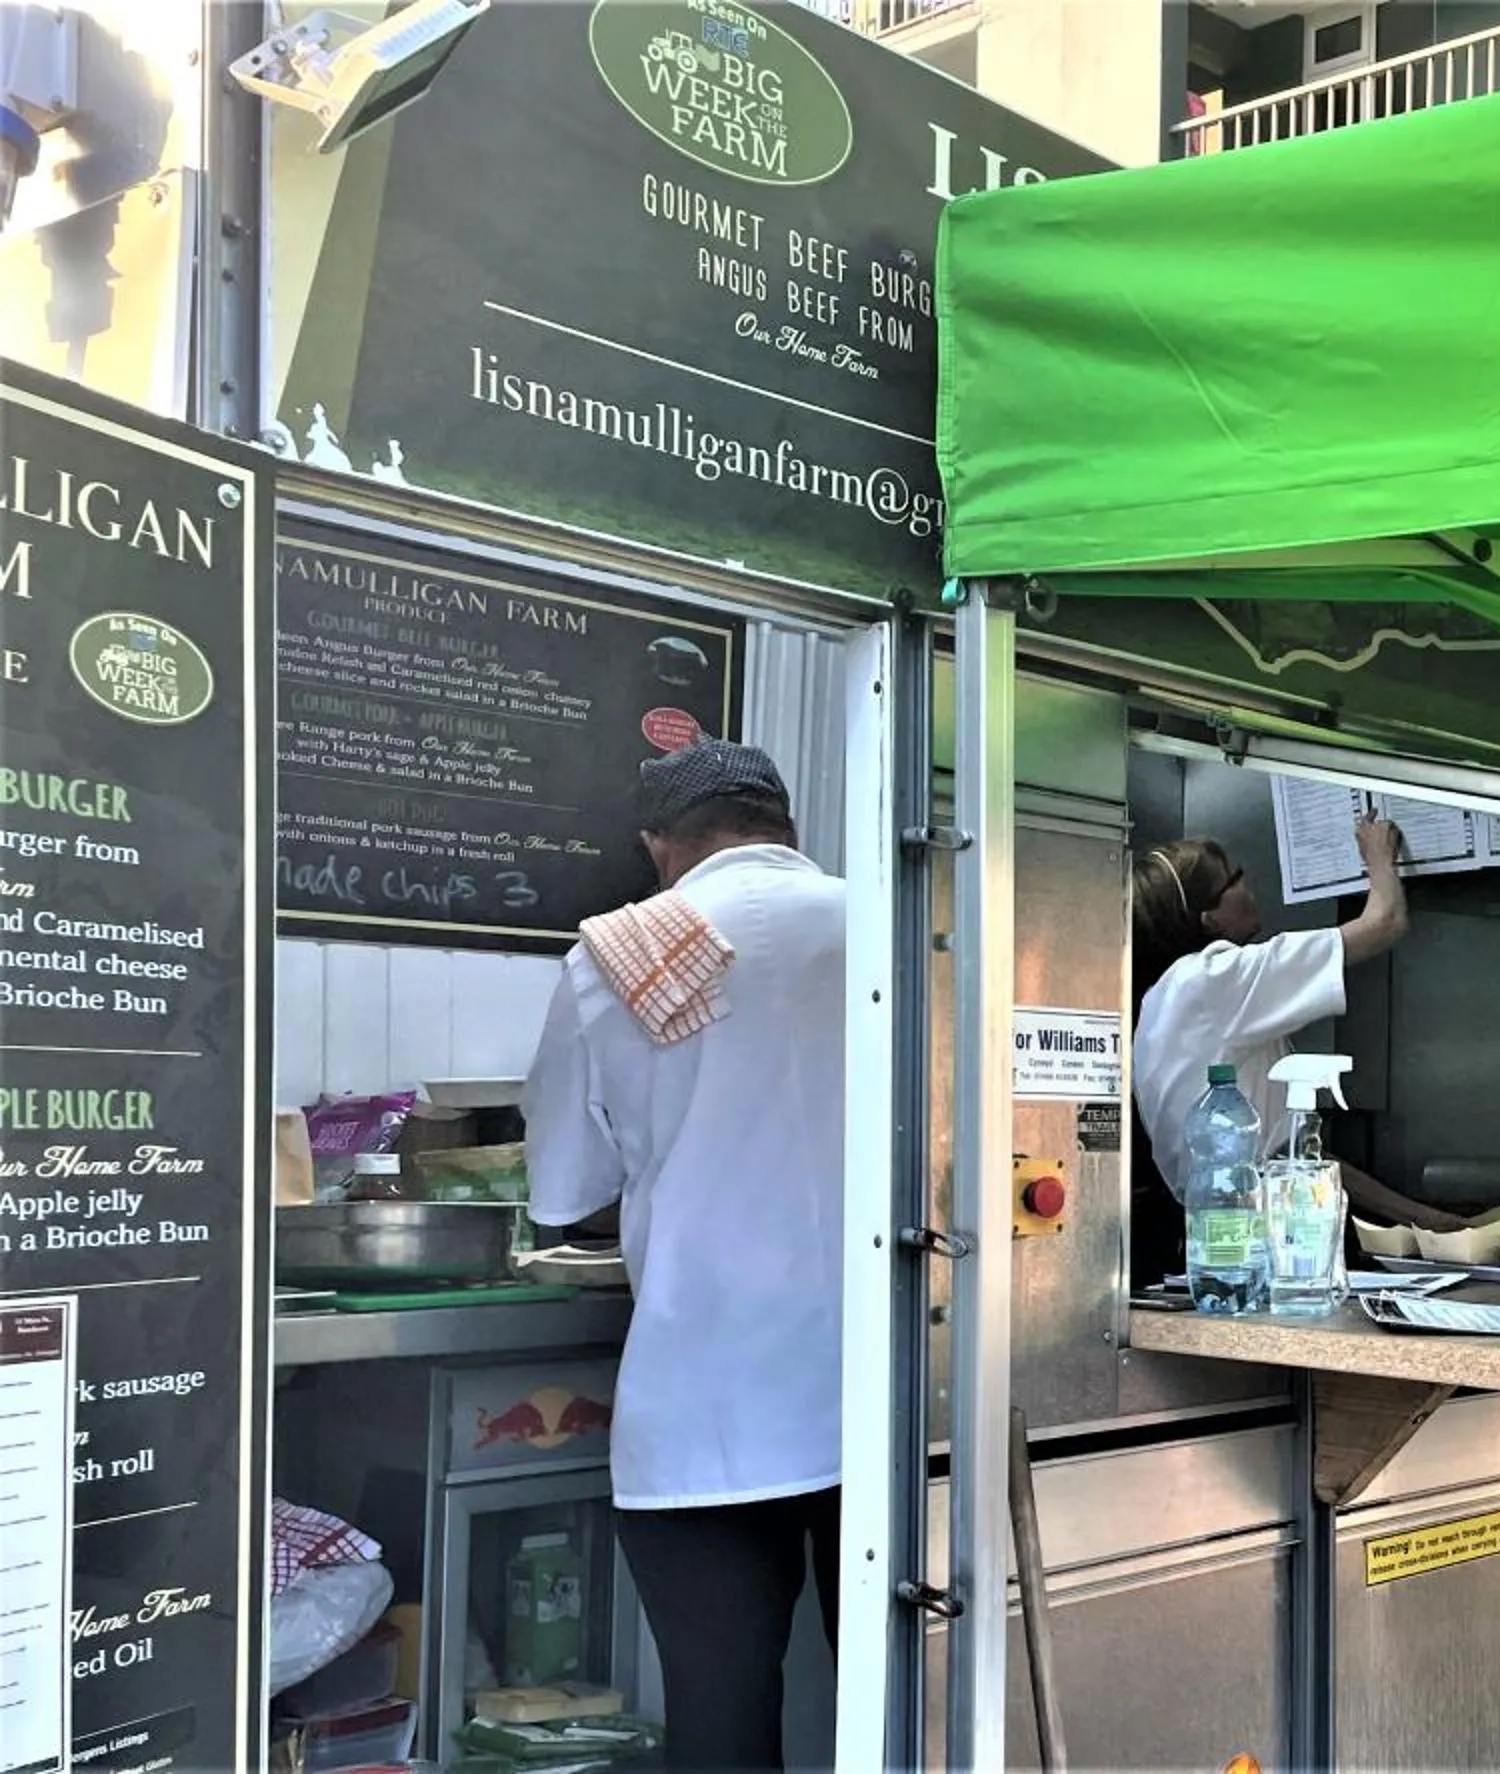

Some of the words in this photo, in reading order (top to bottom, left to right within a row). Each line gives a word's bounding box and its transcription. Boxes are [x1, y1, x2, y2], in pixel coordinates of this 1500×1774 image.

[747, 16, 767, 40] On
[640, 54, 758, 131] WEEK
[722, 53, 783, 104] BIG
[670, 105, 788, 177] FARM
[926, 121, 1048, 200] LI
[641, 173, 765, 251] GOURMET
[788, 229, 848, 283] BEEF
[871, 261, 931, 318] BURG
[698, 247, 767, 302] ANGUS
[787, 280, 840, 326] BEEF
[859, 305, 913, 353] FROM
[735, 311, 773, 345] Our
[775, 325, 828, 364] Home
[831, 343, 880, 380] Farm
[0, 455, 216, 569] LIGAN
[506, 599, 588, 635] FARM
[96, 659, 164, 694] WEEK
[141, 652, 177, 676] BIG
[113, 686, 179, 717] FARM
[0, 767, 131, 823] BURGER
[75, 835, 140, 865] from
[33, 911, 205, 949] Caramelised
[95, 953, 188, 981] cheese
[113, 989, 167, 1015] Bun
[1038, 1029, 1107, 1054] Williams
[48, 1088, 155, 1130] BURGER
[35, 1145, 122, 1178] Home
[128, 1145, 204, 1175] Farm
[0, 1190, 79, 1221] Apple
[84, 1188, 144, 1219] jelly
[20, 1233, 37, 1251] a
[46, 1223, 151, 1249] Brioche
[158, 1221, 209, 1244] Bun
[103, 1370, 206, 1399] sausage
[111, 1448, 154, 1477] roll
[137, 1587, 211, 1623] Farm
[114, 1637, 153, 1668] Oil
